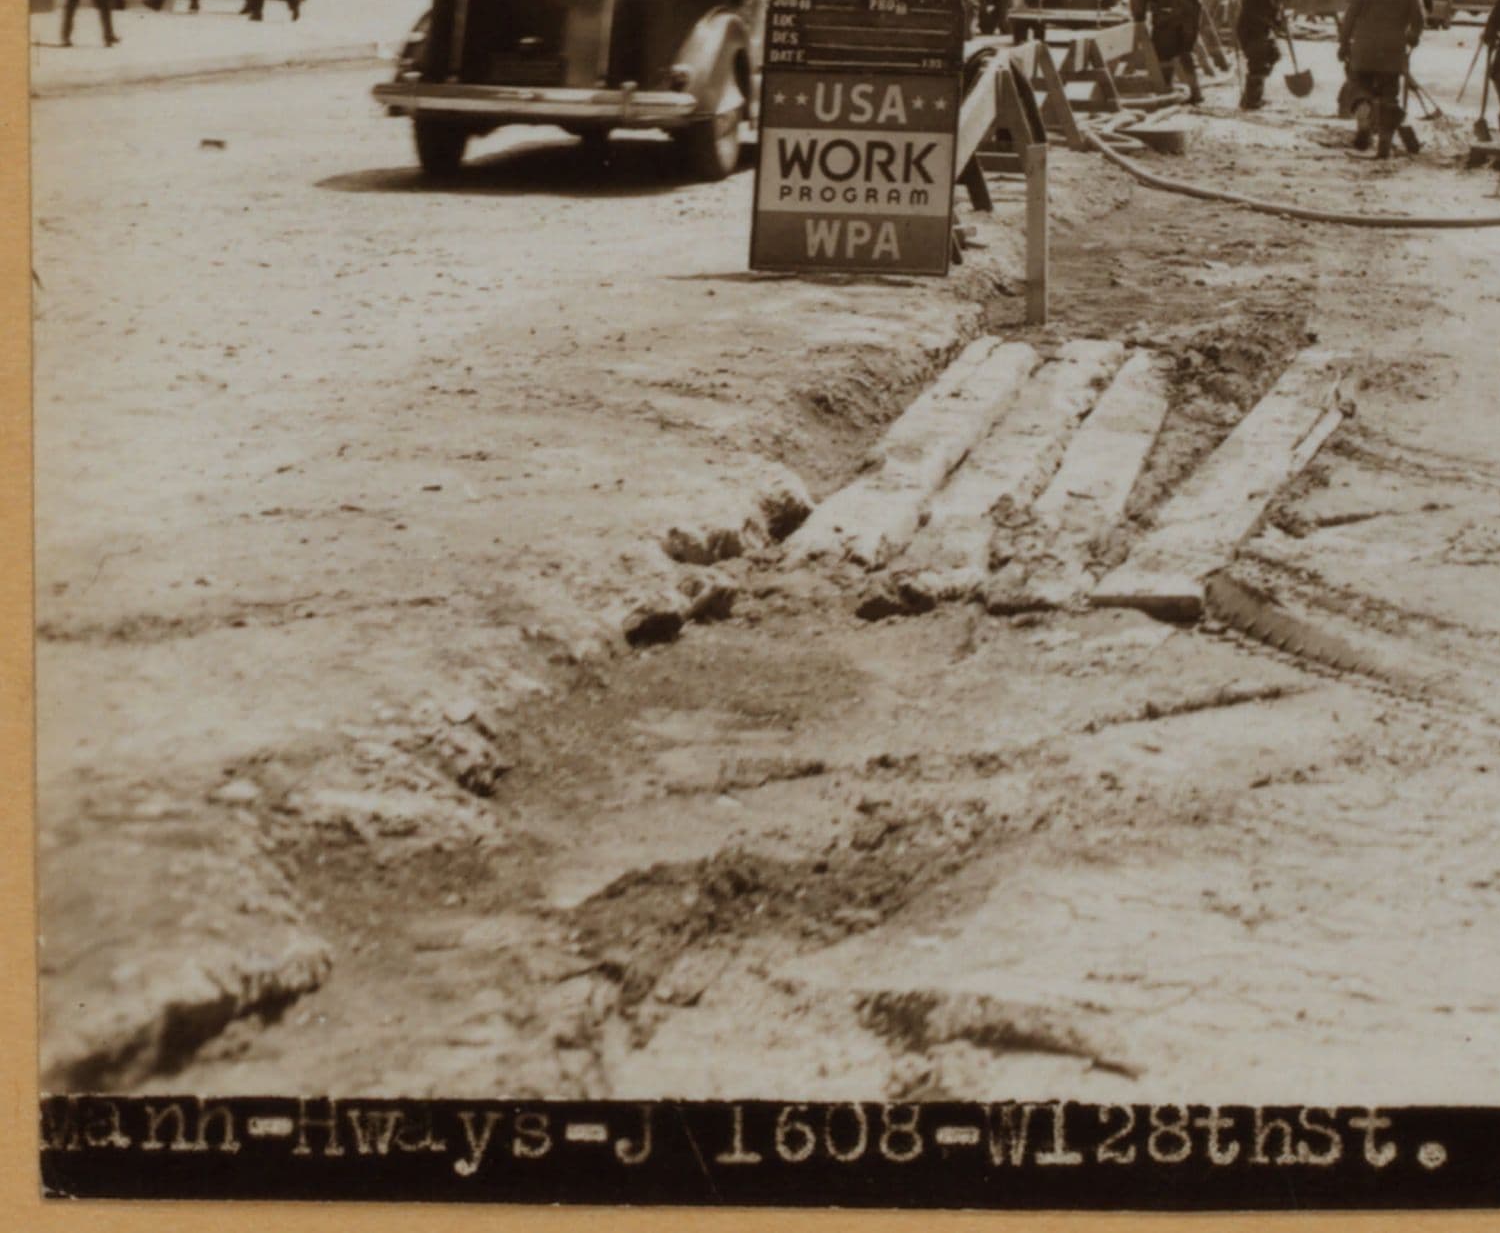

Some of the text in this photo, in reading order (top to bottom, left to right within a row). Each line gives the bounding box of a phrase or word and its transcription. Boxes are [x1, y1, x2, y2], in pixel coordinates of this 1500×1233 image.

[769, 49, 805, 63] DATE
[814, 82, 908, 124] USA
[778, 138, 938, 184] WORK
[779, 185, 929, 205] PROGRAM
[805, 219, 900, 260] WPA
